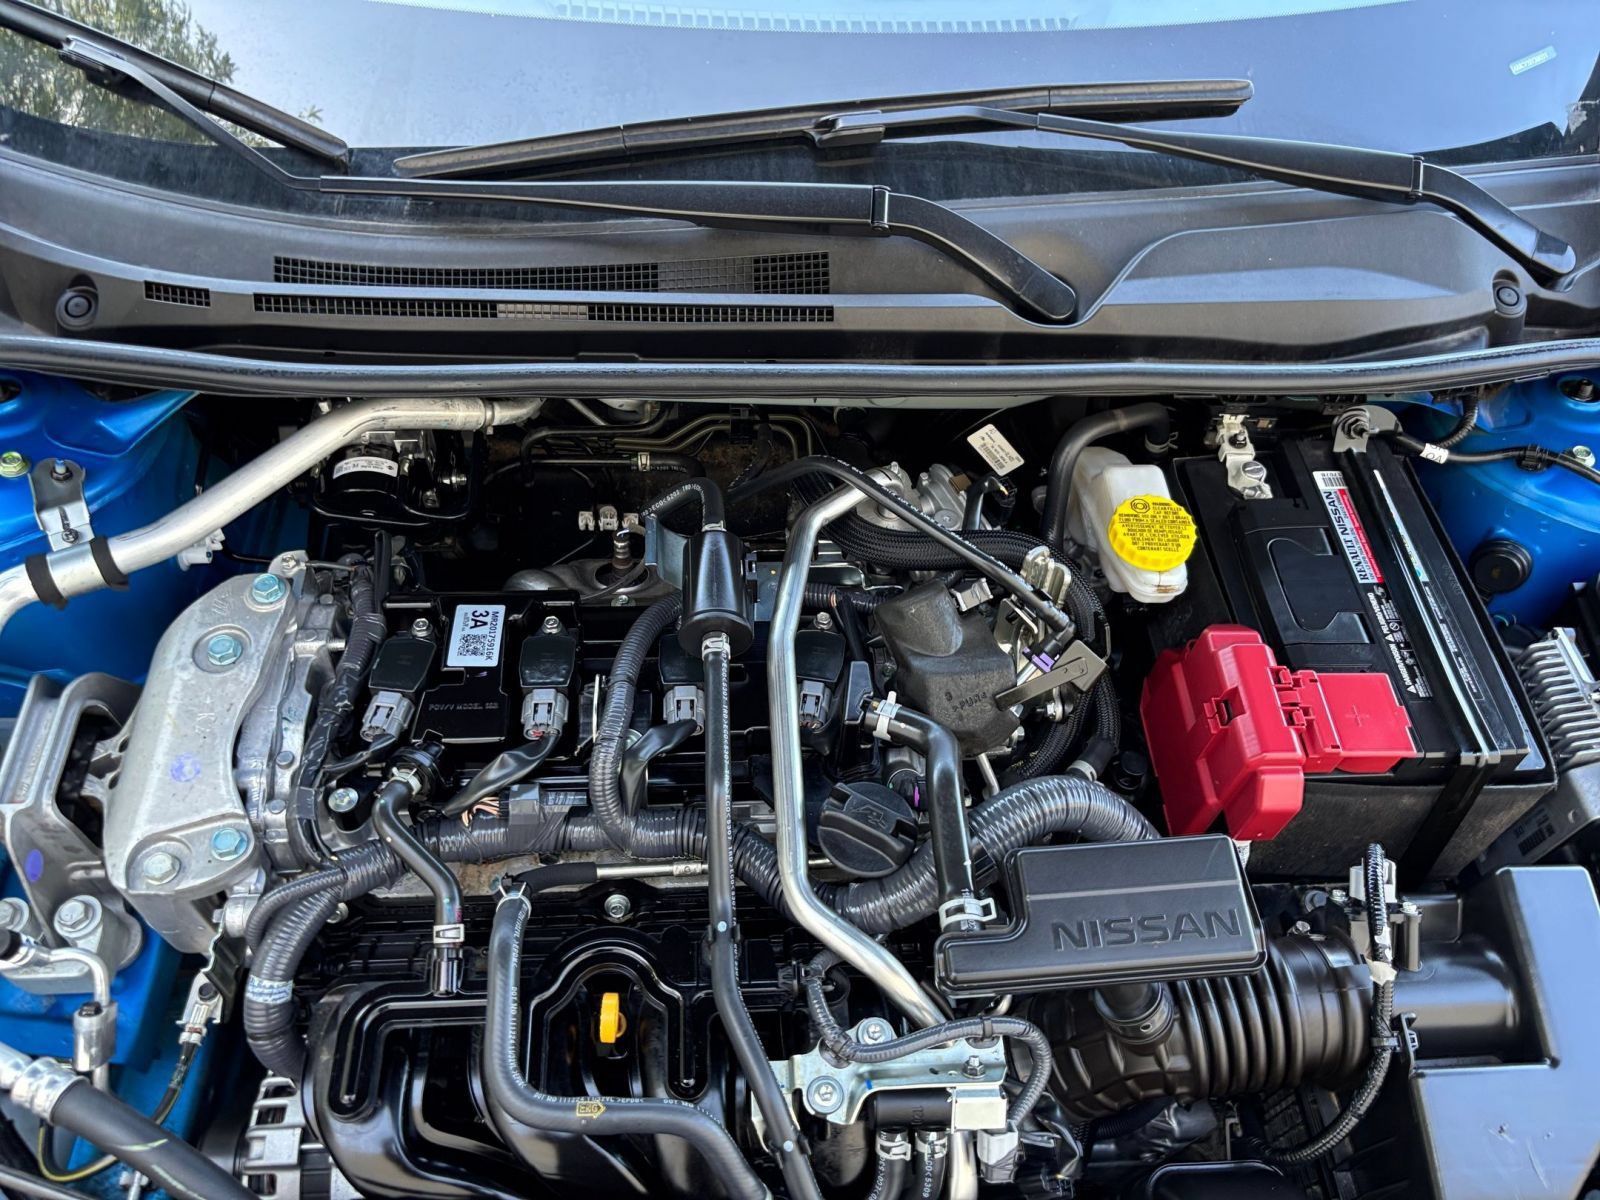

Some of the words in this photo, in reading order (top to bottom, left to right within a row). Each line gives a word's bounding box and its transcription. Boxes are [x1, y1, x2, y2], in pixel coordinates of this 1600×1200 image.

[1323, 491, 1349, 534] NISSAN
[1343, 538, 1369, 579] RENAULT
[469, 610, 489, 628] 3A
[485, 610, 498, 660] MR20175916K
[1051, 909, 1241, 951] NISSAN
